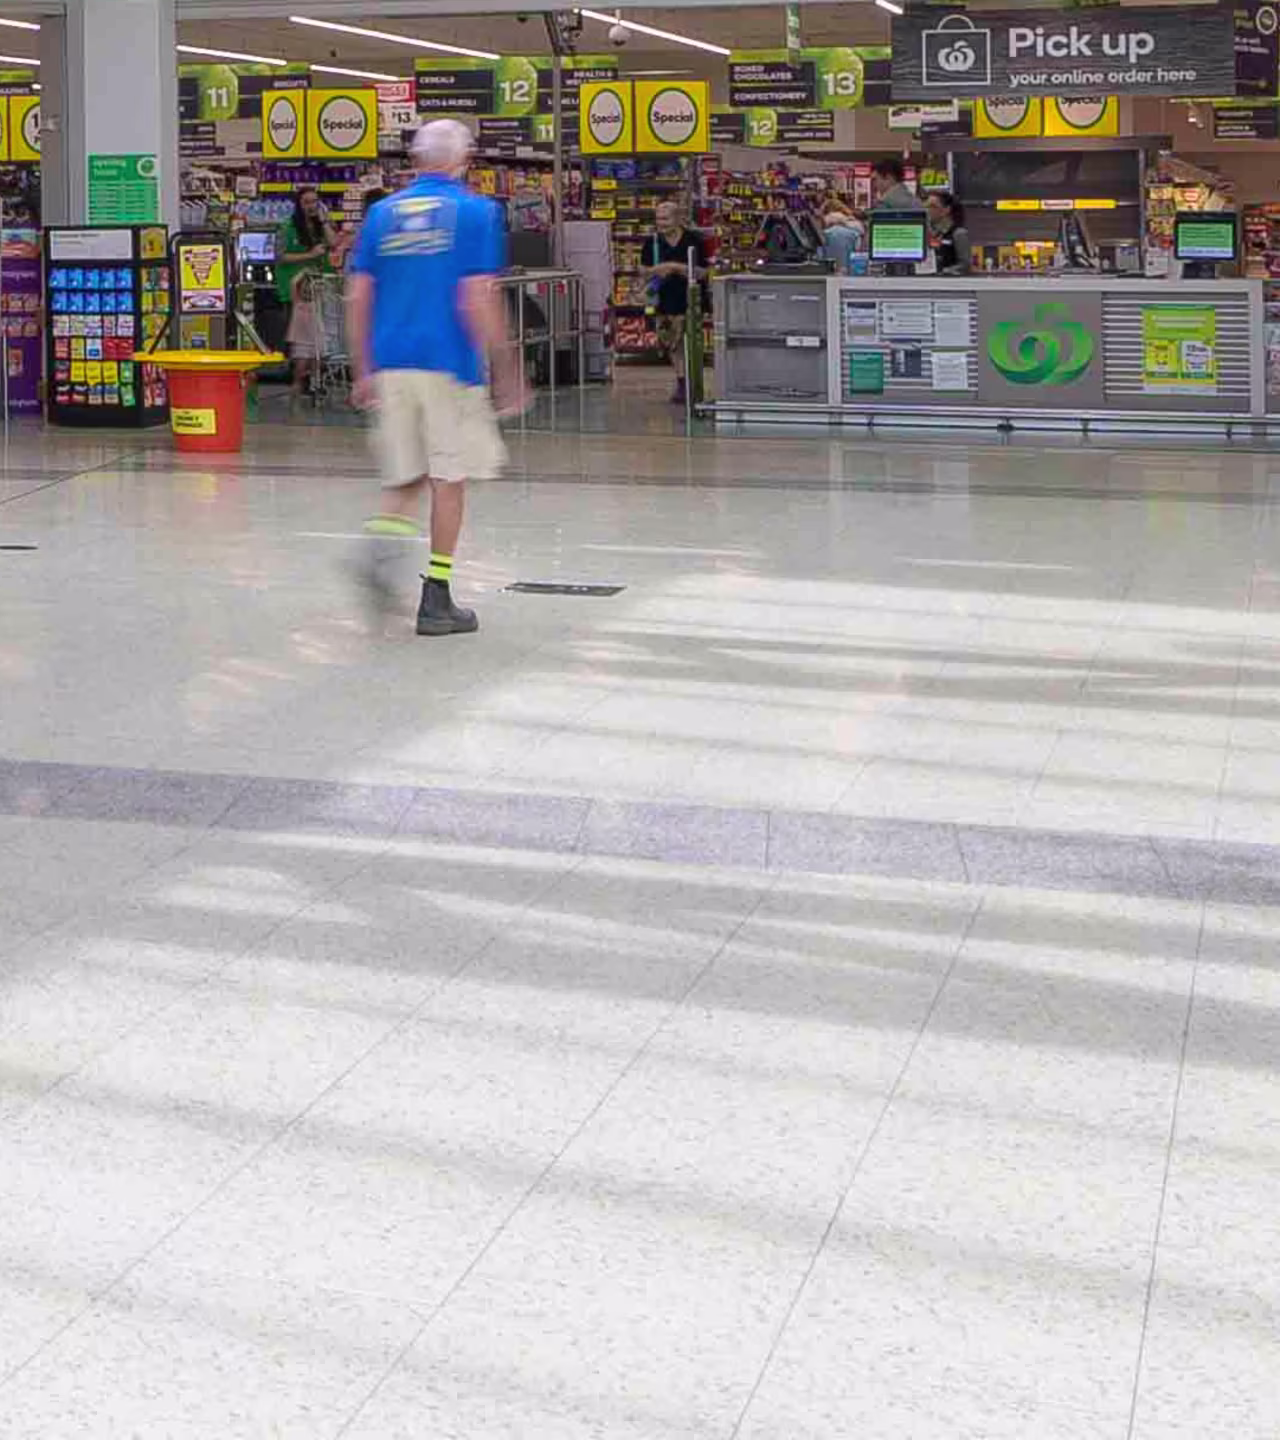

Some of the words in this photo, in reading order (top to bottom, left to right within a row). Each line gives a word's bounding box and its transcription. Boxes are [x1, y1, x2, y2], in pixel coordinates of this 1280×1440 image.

[1008, 26, 1093, 57] Pick
[1101, 32, 1155, 63] up
[823, 71, 856, 96] 13
[1010, 73, 1047, 88] your
[1051, 70, 1104, 84] online
[1107, 68, 1153, 83] order
[1157, 68, 1197, 82] here
[208, 86, 229, 108] 11
[500, 80, 530, 102] 12
[322, 118, 364, 131] Special
[592, 111, 620, 128] Special
[653, 109, 694, 126] Special
[749, 120, 773, 136] 12
